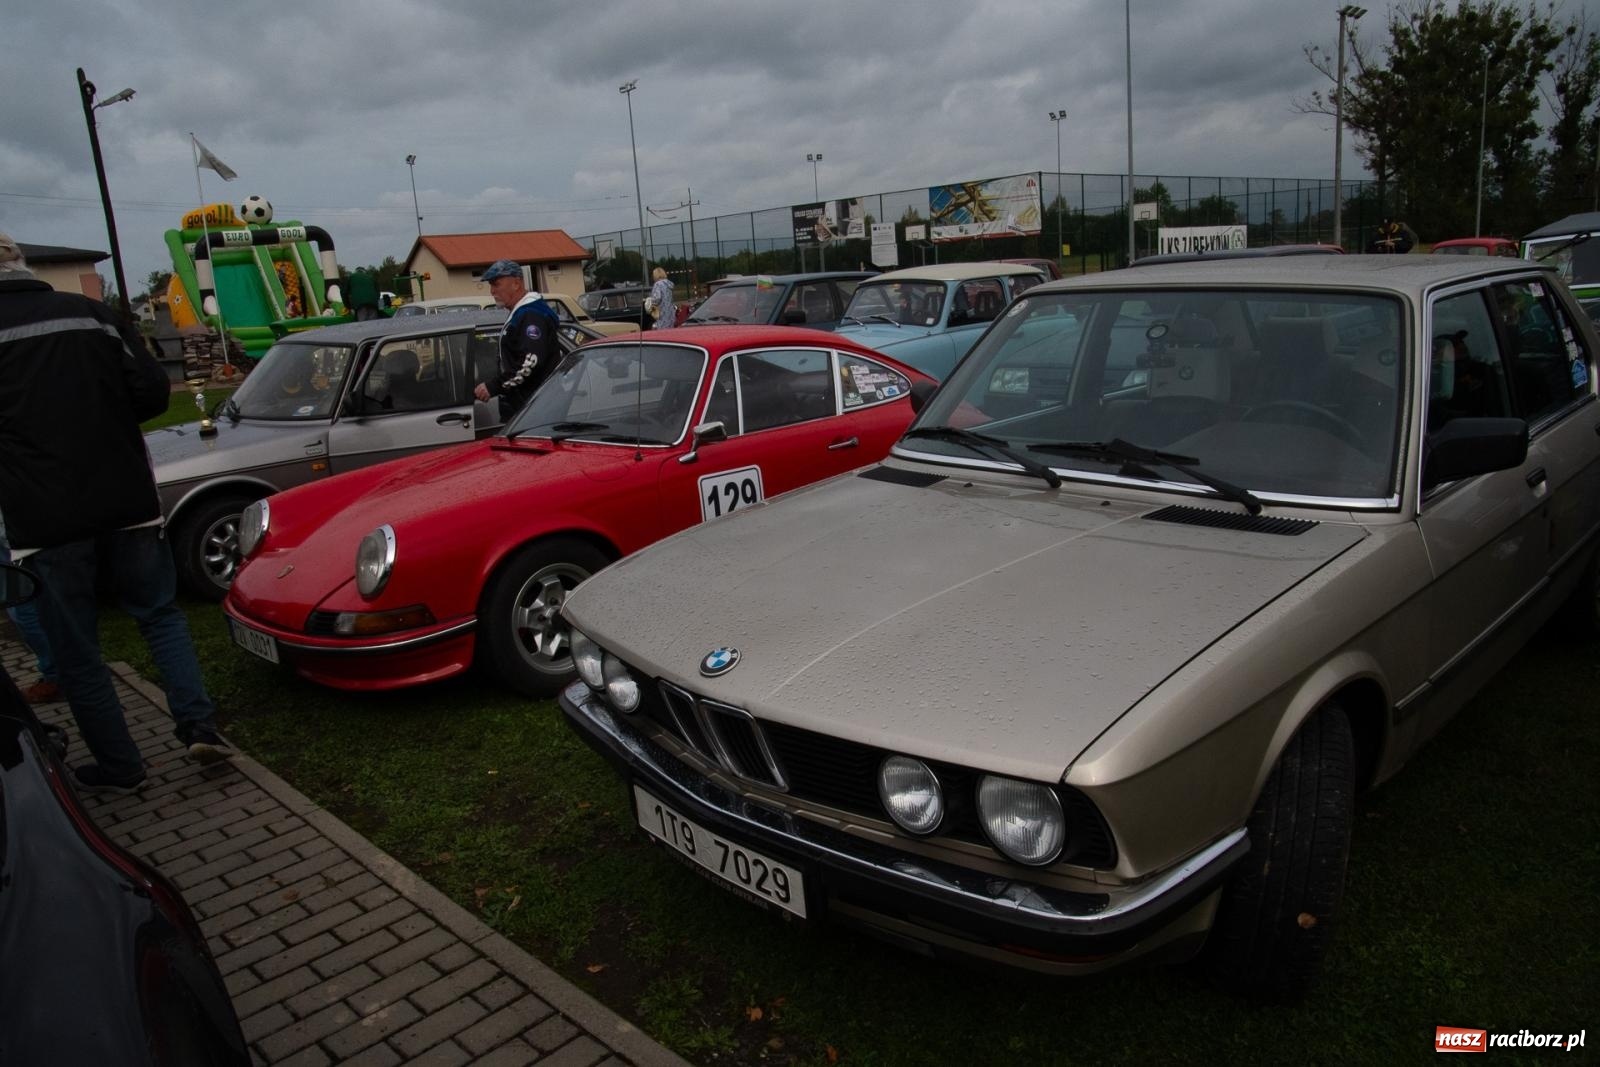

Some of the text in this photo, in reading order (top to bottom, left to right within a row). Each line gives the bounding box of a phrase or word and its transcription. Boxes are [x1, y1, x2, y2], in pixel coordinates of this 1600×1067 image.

[225, 232, 250, 241] EURO
[708, 478, 757, 518] 129
[655, 804, 696, 855] 1T9
[714, 838, 791, 903] 7029
